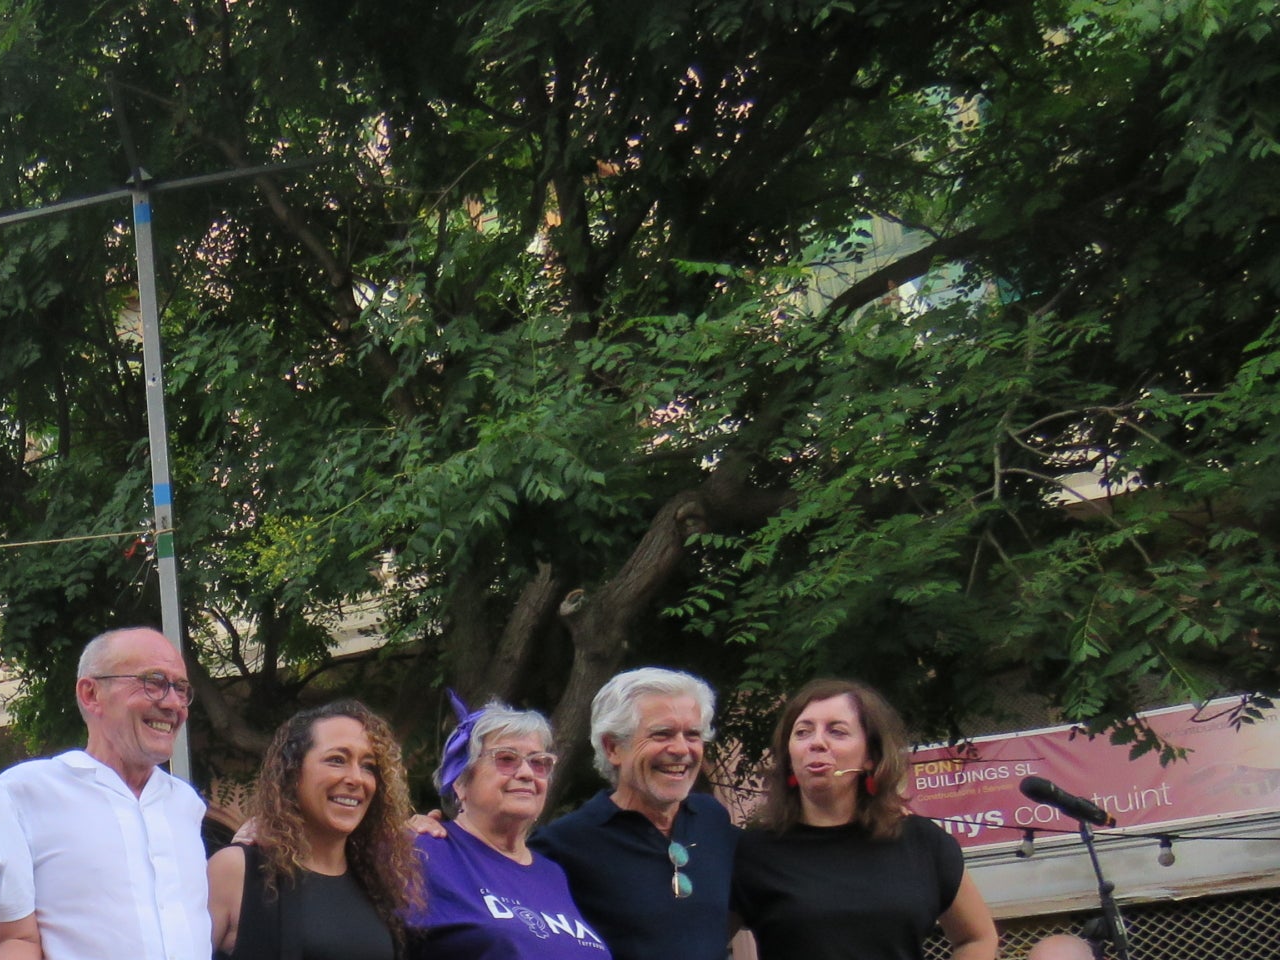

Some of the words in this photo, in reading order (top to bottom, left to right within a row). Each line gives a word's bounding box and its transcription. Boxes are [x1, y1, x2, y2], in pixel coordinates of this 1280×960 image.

[914, 758, 963, 777] FONT
[916, 766, 1010, 790] BUILDINGS
[1015, 763, 1038, 777] SL
